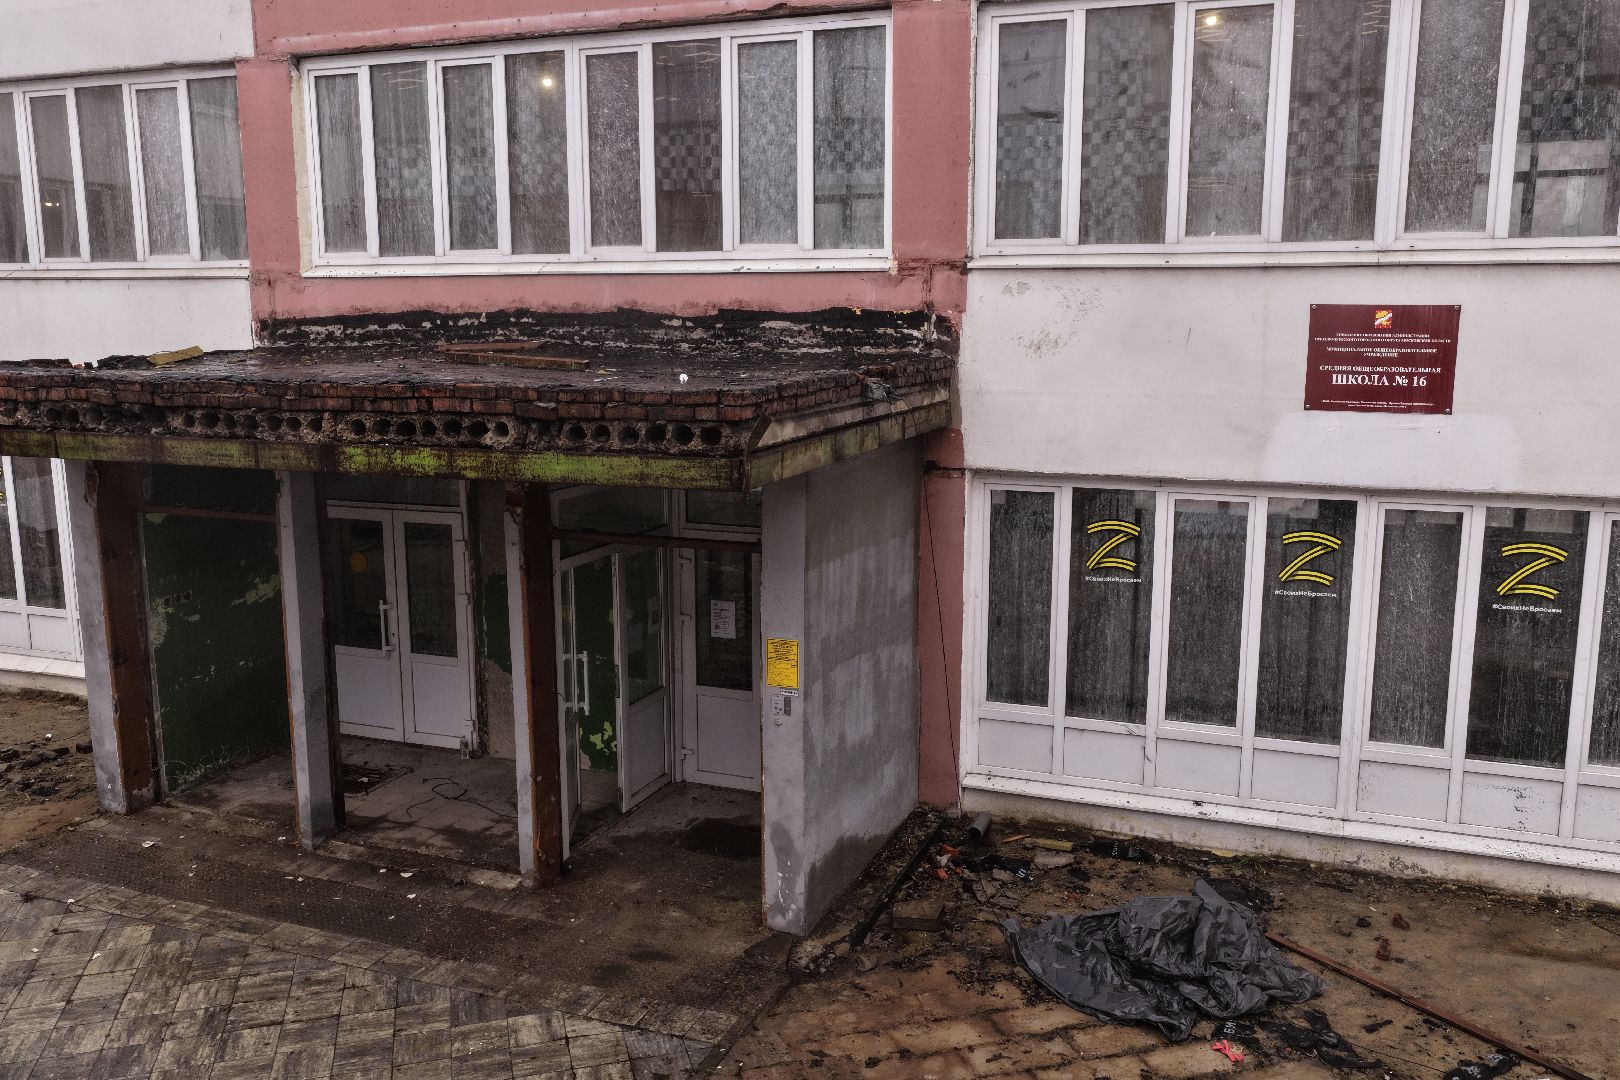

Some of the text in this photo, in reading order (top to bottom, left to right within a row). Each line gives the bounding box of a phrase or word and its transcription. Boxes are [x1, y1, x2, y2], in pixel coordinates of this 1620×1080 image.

[1331, 373, 1428, 387] ШКОЛА № 16
[1352, 365, 1442, 373] ОБЩЕОБРАЗОВАТЕЛЬНАЯ
[1086, 520, 1141, 572] Z
[1279, 531, 1342, 587] Z
[1497, 543, 1569, 600] Z
